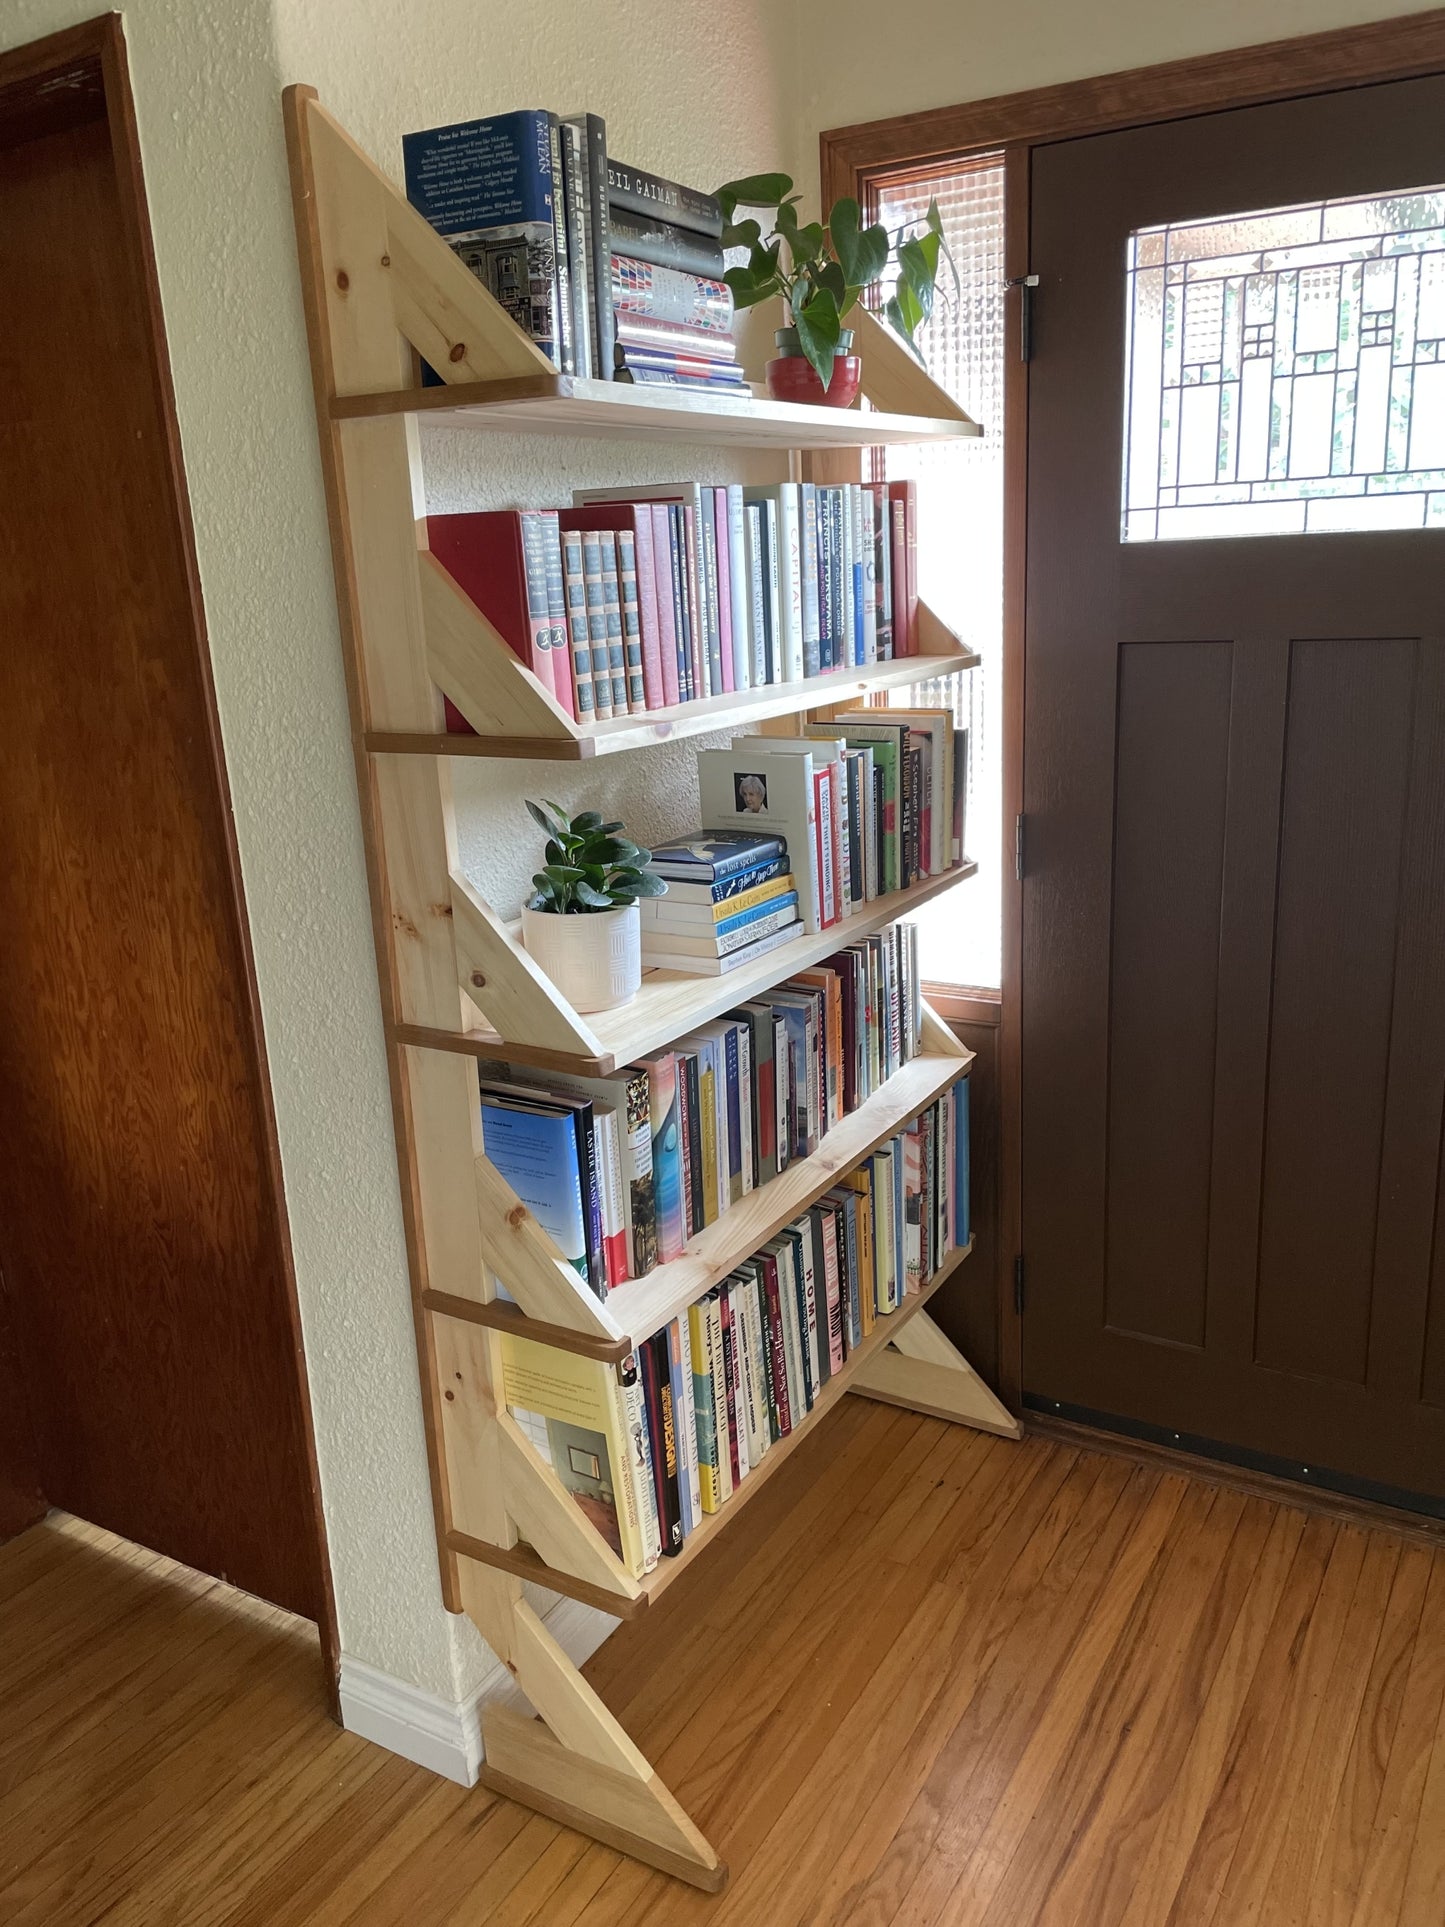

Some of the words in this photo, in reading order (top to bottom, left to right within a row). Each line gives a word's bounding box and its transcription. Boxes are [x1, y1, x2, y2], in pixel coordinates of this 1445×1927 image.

[550, 127, 561, 167] small
[553, 172, 562, 185] is
[607, 167, 631, 191] EIL
[636, 178, 678, 207] GAIMAN
[553, 188, 566, 254] beautiful
[599, 185, 607, 235] HUMANS
[602, 243, 608, 256] OF
[558, 266, 572, 348] Schumacher
[806, 498, 817, 582] COLLAPSE
[822, 500, 830, 560] FRANCIS
[790, 527, 801, 614] CAPITAL
[835, 554, 839, 564] OF
[755, 591, 763, 663] MAINTENANCE
[726, 861, 740, 873] lost
[739, 855, 757, 870] spells
[715, 904, 733, 919] Ursula
[891, 992, 901, 1056] UPHEAVAL
[741, 1050, 749, 1077] Growth
[586, 1130, 595, 1168] EASTER
[589, 1171, 598, 1207] ISLAND
[823, 1221, 836, 1245] THE
[825, 1246, 839, 1288] UPSIDE
[805, 1269, 816, 1332] HOME
[828, 1289, 840, 1301] OF
[712, 1317, 722, 1342] THE
[773, 1319, 783, 1350] House
[683, 1320, 694, 1403] BEAUTIFUL
[705, 1314, 713, 1355] Henry's
[709, 1361, 717, 1433] WONDERFUL
[714, 1344, 725, 1387] FRENCH
[739, 1313, 748, 1353] GREENBERG
[744, 1357, 754, 1402] MID-CENTURY
[749, 1404, 757, 1434] MODERN
[727, 1380, 735, 1414] GARDEN
[778, 1375, 786, 1391] Not
[625, 1391, 638, 1421] DECO
[717, 1392, 729, 1432] TOUCH
[737, 1406, 745, 1444] BELLATI
[780, 1404, 790, 1431] Inside
[663, 1419, 678, 1468] DESIGN
[688, 1409, 698, 1472] BRITAIN
[620, 1456, 628, 1471] AND
[622, 1472, 636, 1527] RESTORATIONS
[637, 1470, 649, 1505] JUDITH
[643, 1510, 655, 1549] MILLER
